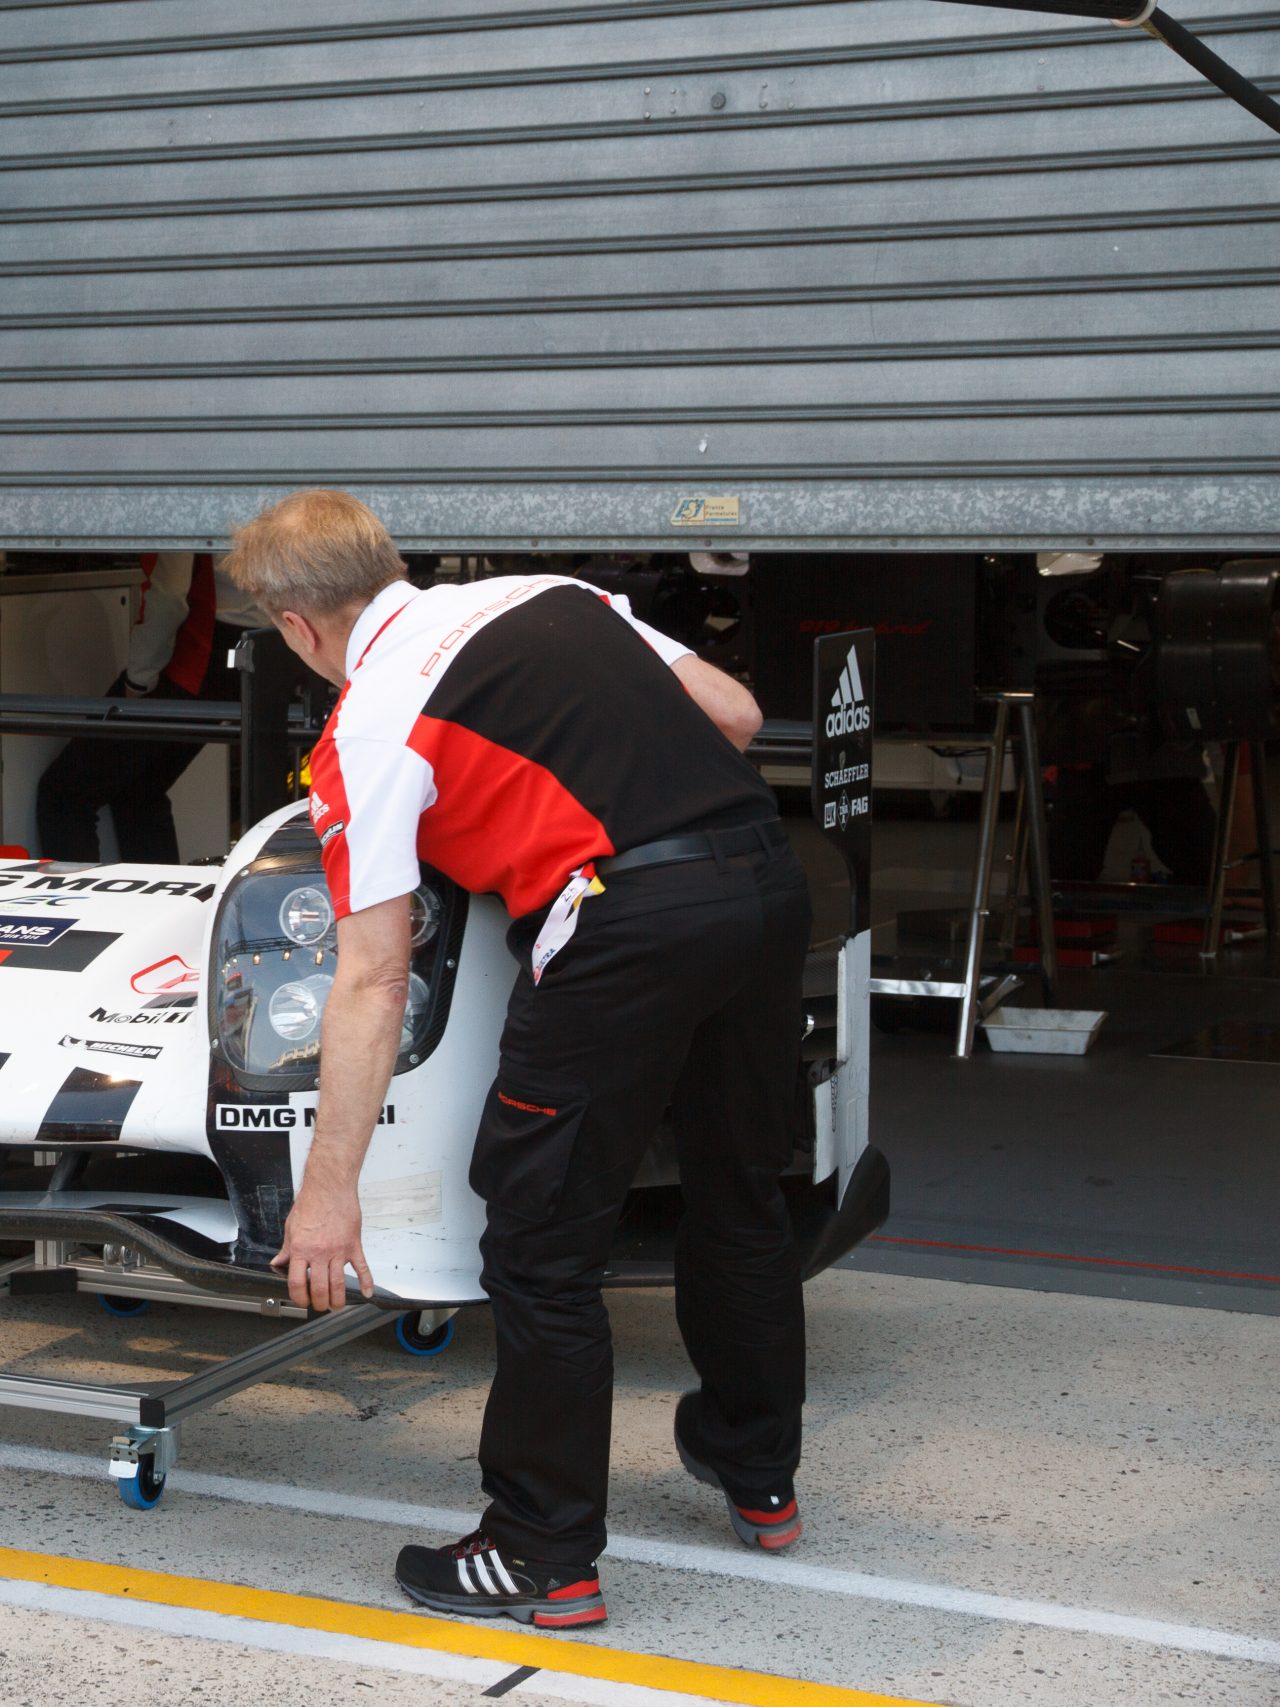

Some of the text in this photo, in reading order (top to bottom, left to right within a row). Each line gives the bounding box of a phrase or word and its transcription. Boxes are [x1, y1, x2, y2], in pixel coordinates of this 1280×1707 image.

[826, 701, 870, 738] adidas
[824, 763, 869, 789] SCHAEFFLER
[851, 796, 869, 817] FAG
[88, 1006, 167, 1024] Mobil
[89, 1041, 163, 1056] MICHELIN
[220, 1107, 297, 1128] DMG
